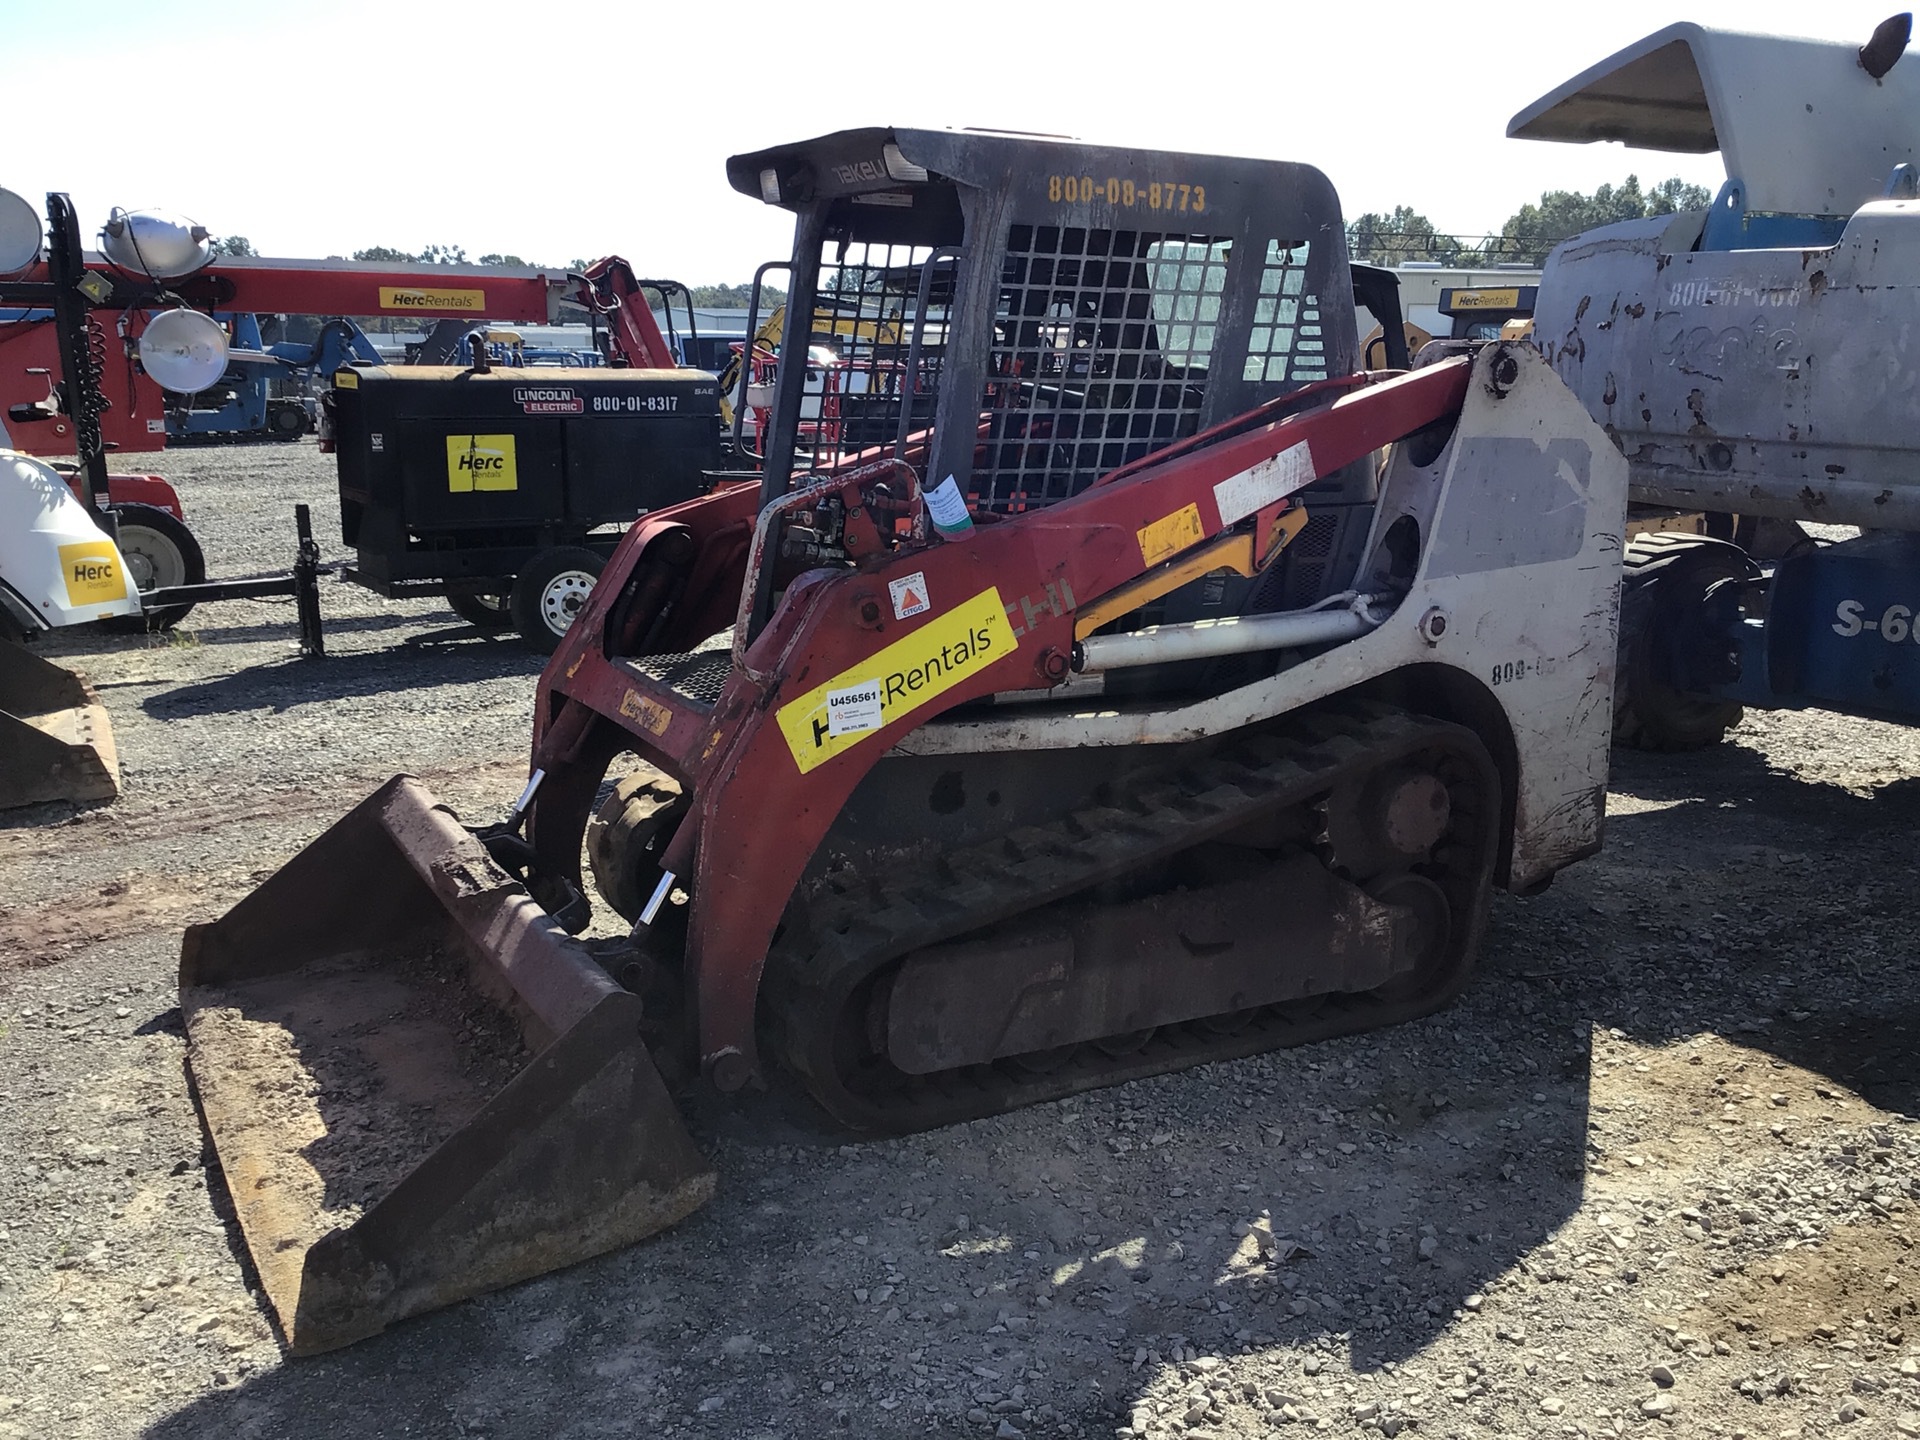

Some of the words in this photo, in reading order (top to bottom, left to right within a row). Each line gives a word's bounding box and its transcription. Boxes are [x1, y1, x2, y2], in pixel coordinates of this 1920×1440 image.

[1049, 175, 1205, 212] 800-08-8773
[393, 294, 473, 307] HercRentals
[1458, 295, 1510, 306] HercRentals
[517, 390, 571, 401] LINCOLN
[531, 403, 578, 411] ELECTRIC
[593, 396, 678, 411] 800-01-8317
[458, 455, 504, 470] Herc
[473, 471, 503, 479] Rentals
[74, 565, 113, 582] Herc
[87, 581, 113, 590] Rentals
[903, 605, 924, 616] CITGO
[812, 626, 992, 748] HRentals
[830, 691, 876, 707] U456561
